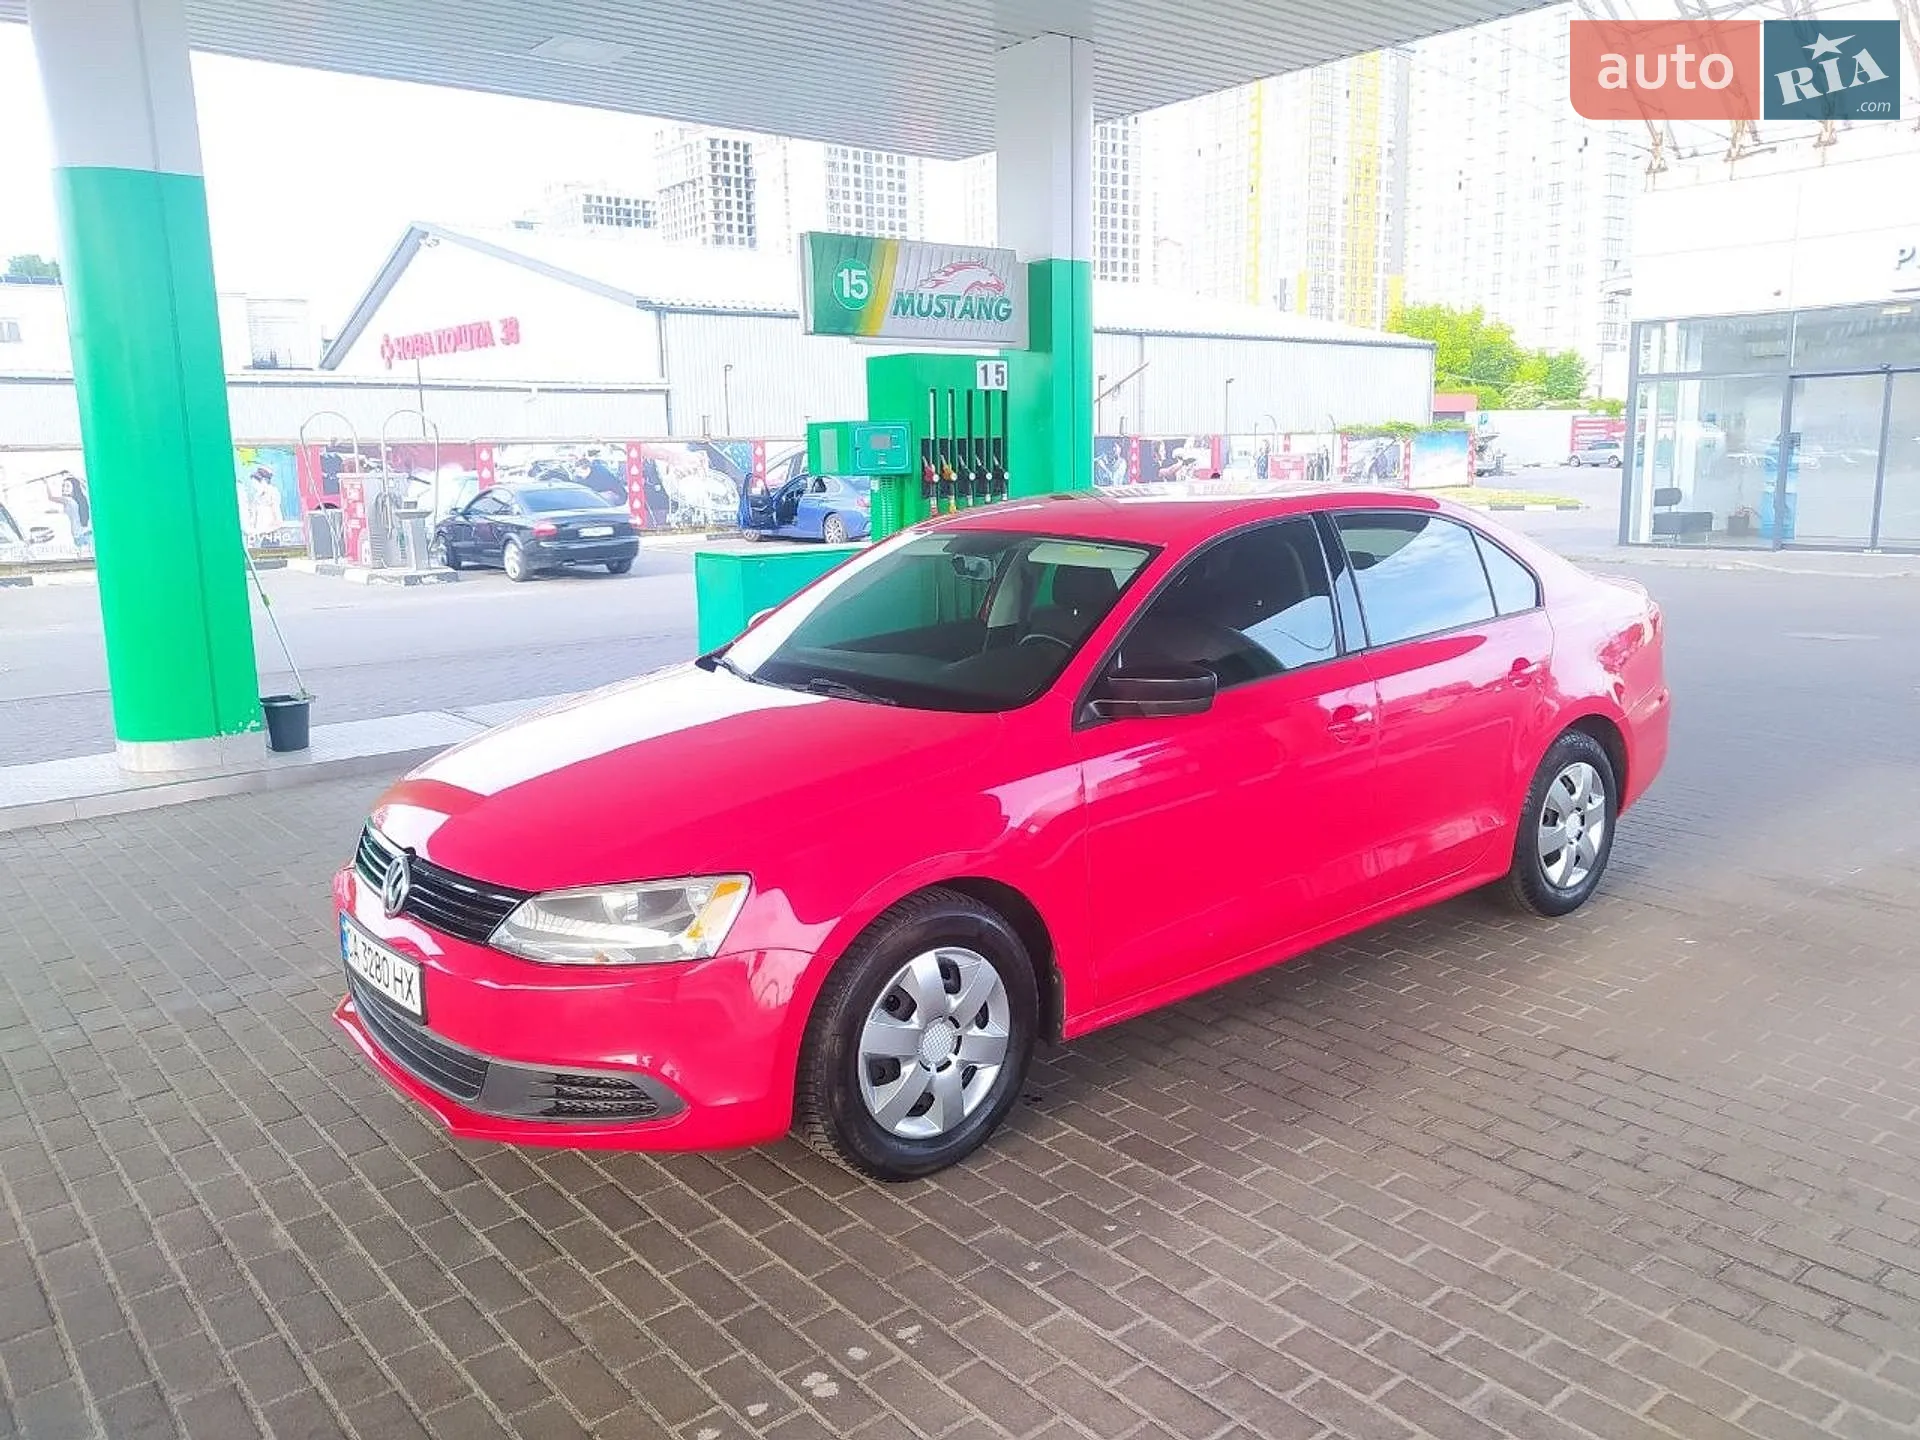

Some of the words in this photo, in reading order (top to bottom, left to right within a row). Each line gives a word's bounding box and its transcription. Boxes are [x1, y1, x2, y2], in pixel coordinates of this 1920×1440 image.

[837, 268, 869, 300] 15
[892, 290, 1013, 322] MUSTANG
[979, 364, 1005, 387] 15
[361, 940, 390, 990] 3280
[392, 962, 416, 1006] HX
